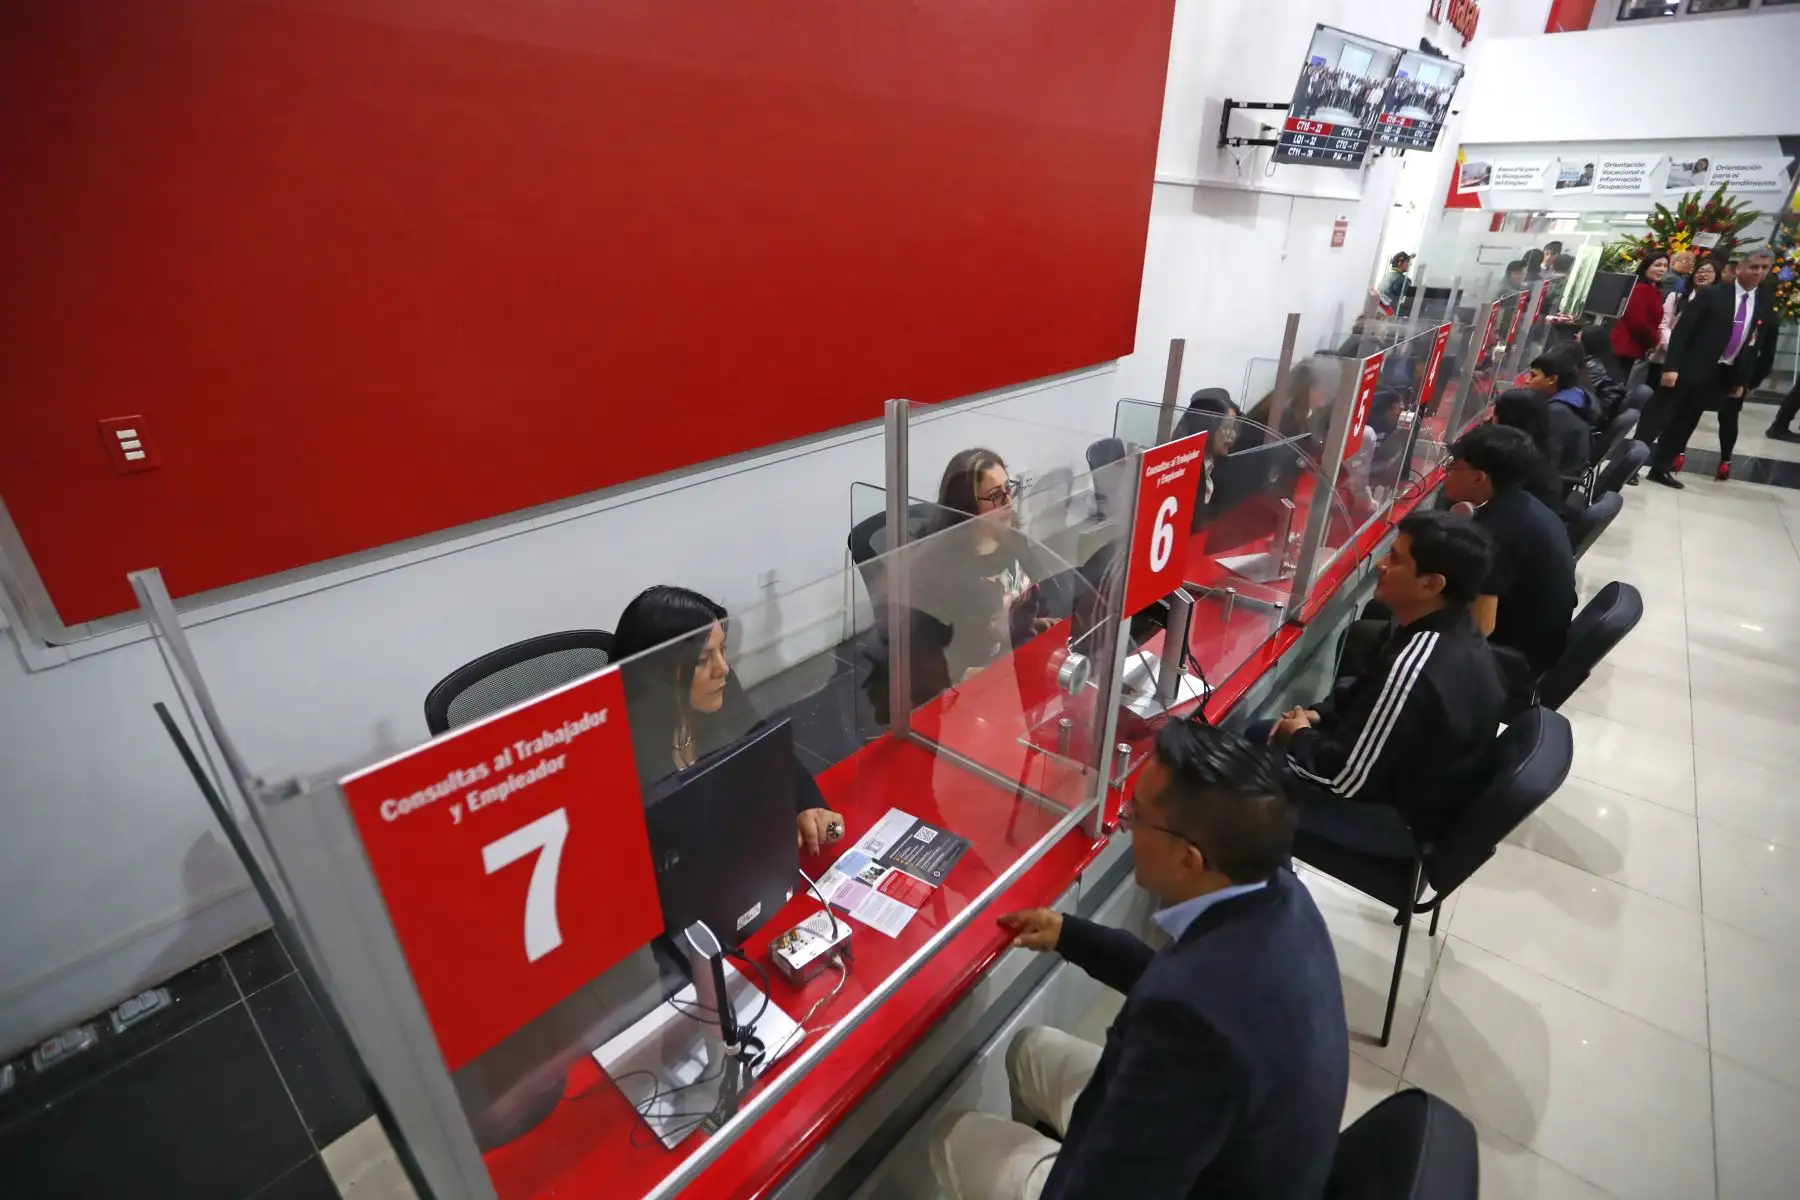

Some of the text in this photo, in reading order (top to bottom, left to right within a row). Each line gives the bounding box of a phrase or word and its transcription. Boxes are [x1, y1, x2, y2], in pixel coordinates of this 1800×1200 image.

[1353, 388, 1370, 437] 5
[1150, 495, 1178, 573] 6
[379, 707, 609, 822] Consultas al Trabajador
[449, 753, 567, 826] y Empleador
[481, 806, 570, 964] 7
